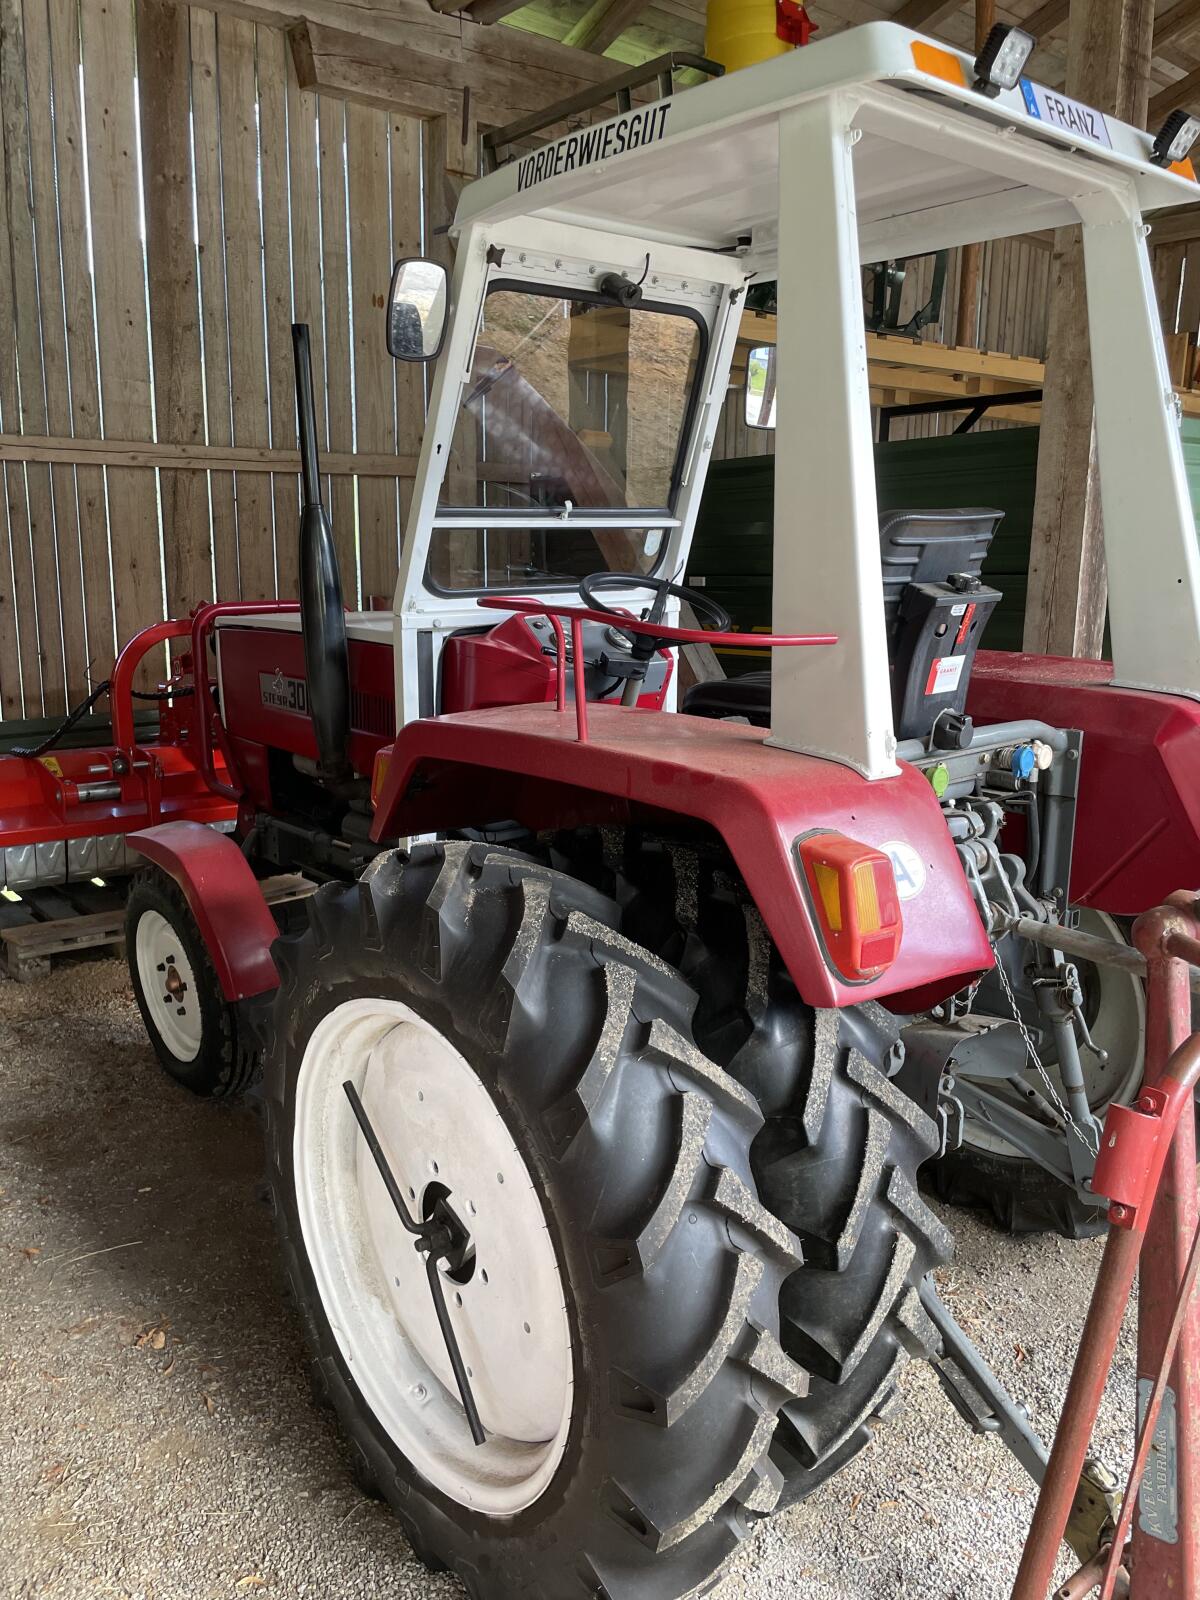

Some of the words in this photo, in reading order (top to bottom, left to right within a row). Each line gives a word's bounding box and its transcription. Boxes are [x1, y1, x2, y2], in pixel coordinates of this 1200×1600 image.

[517, 103, 671, 192] VORDERWIESGUT
[1044, 94, 1100, 140] FRANZ
[891, 851, 916, 888] A
[1156, 1427, 1167, 1504] FABRIKK
